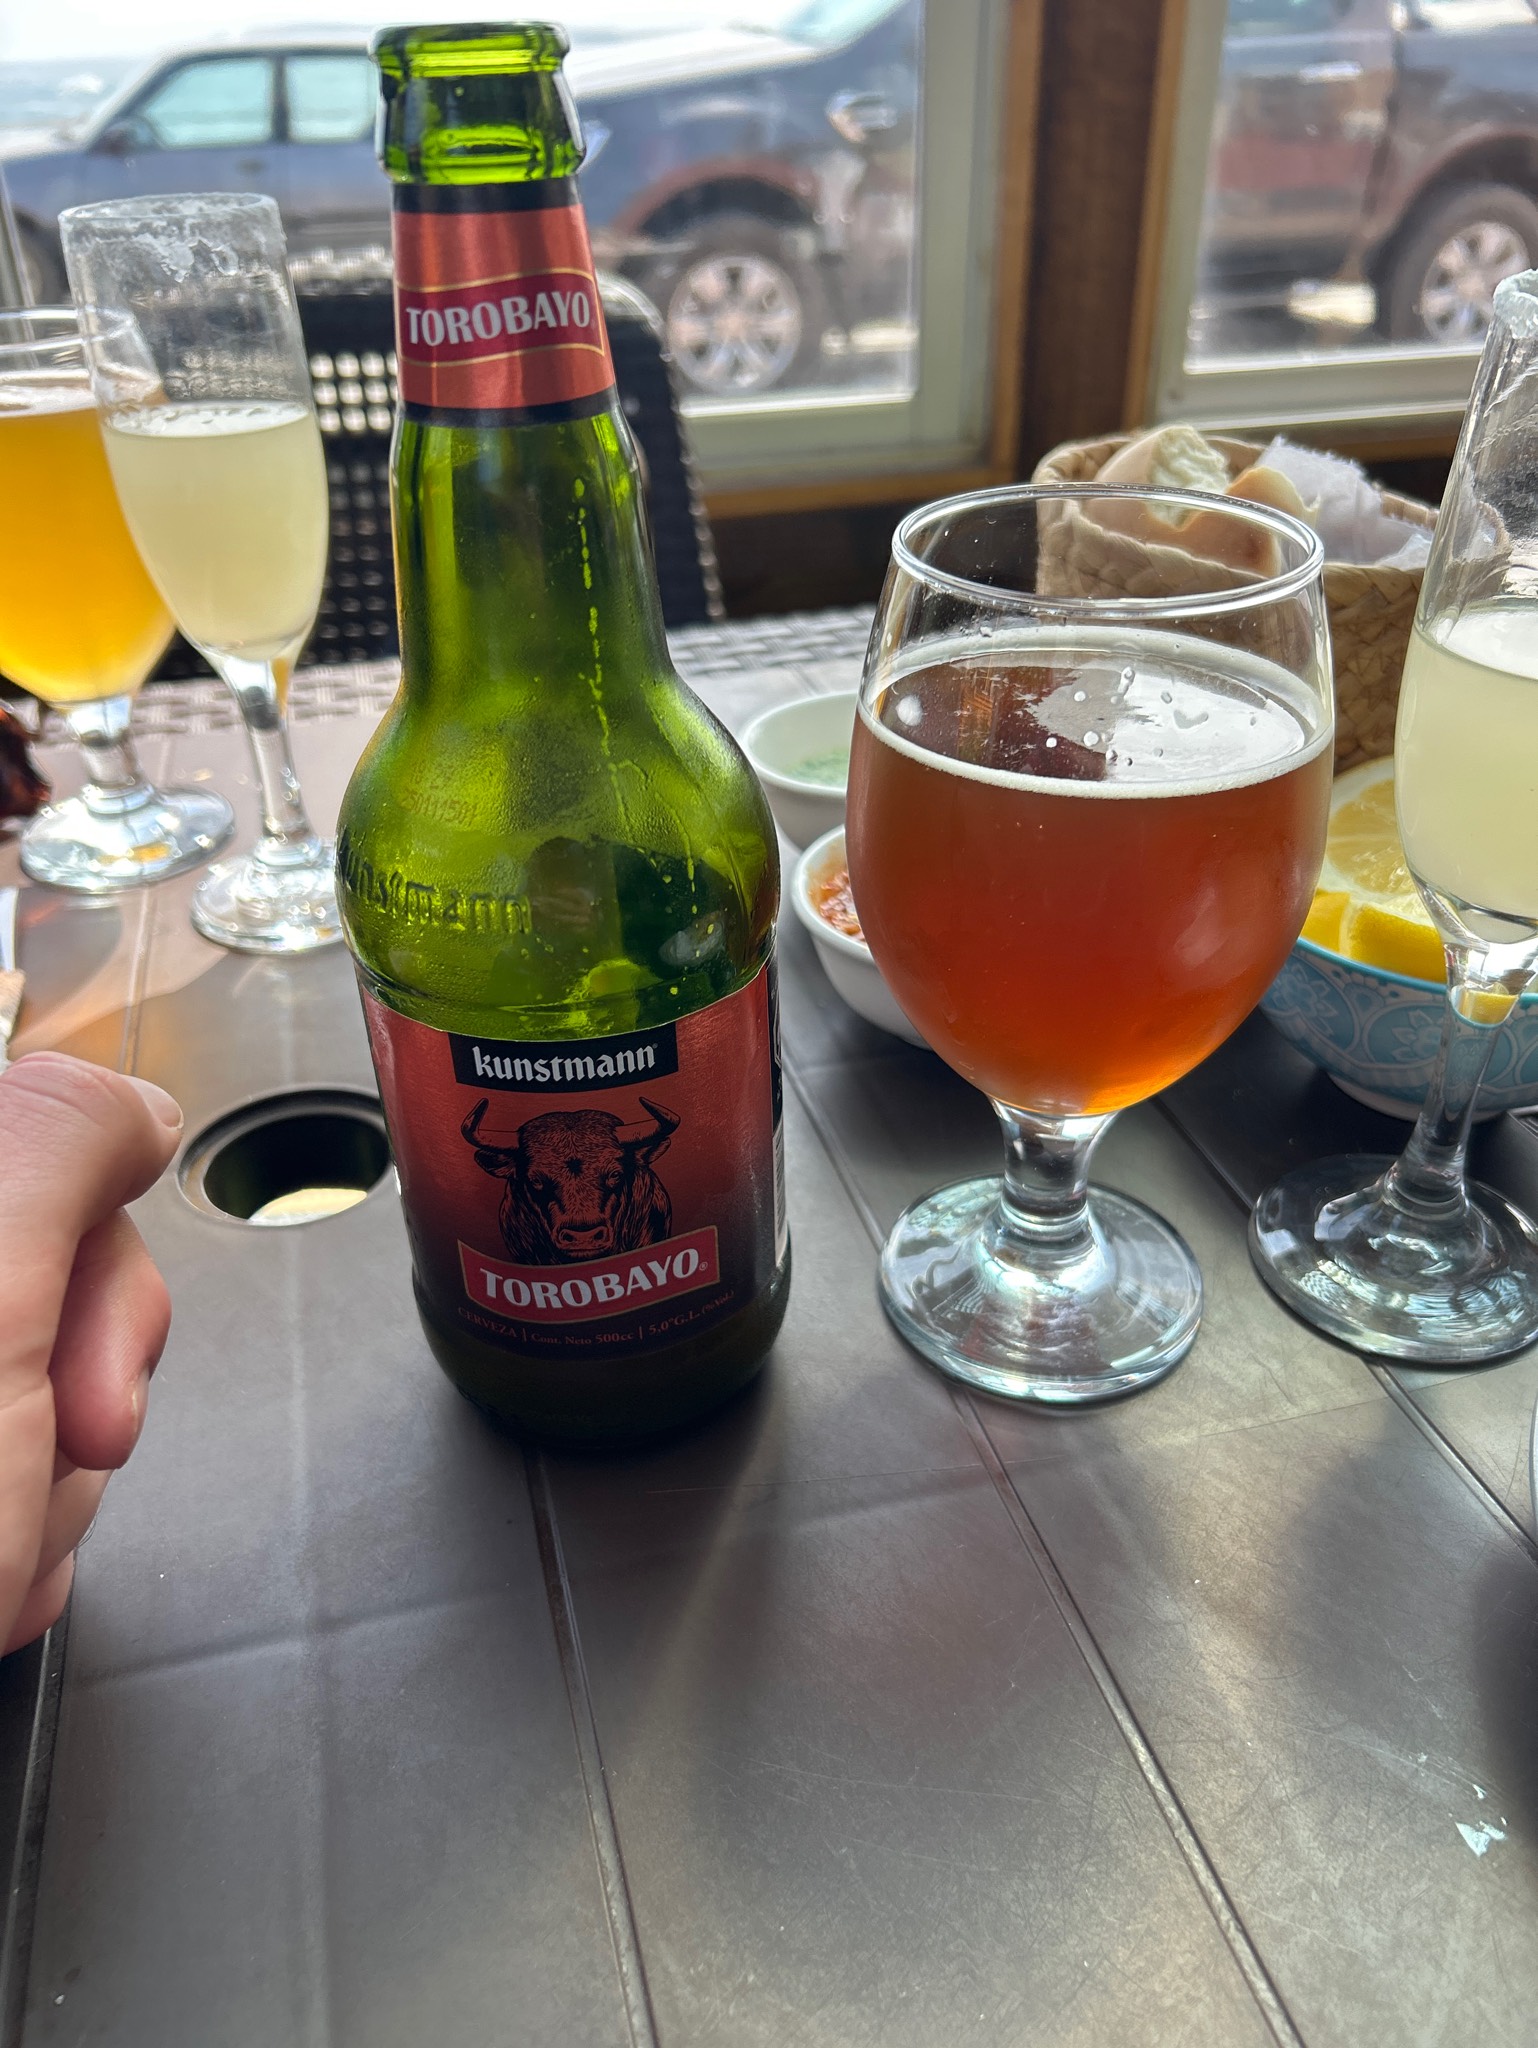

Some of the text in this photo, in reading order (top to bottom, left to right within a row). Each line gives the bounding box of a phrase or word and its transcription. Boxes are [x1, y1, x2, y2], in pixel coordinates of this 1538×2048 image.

[406, 291, 591, 347] TOROBAYO
[457, 1306, 518, 1339] CERVEZA
[565, 1335, 592, 1345] Neto
[595, 1331, 634, 1344] 500cc
